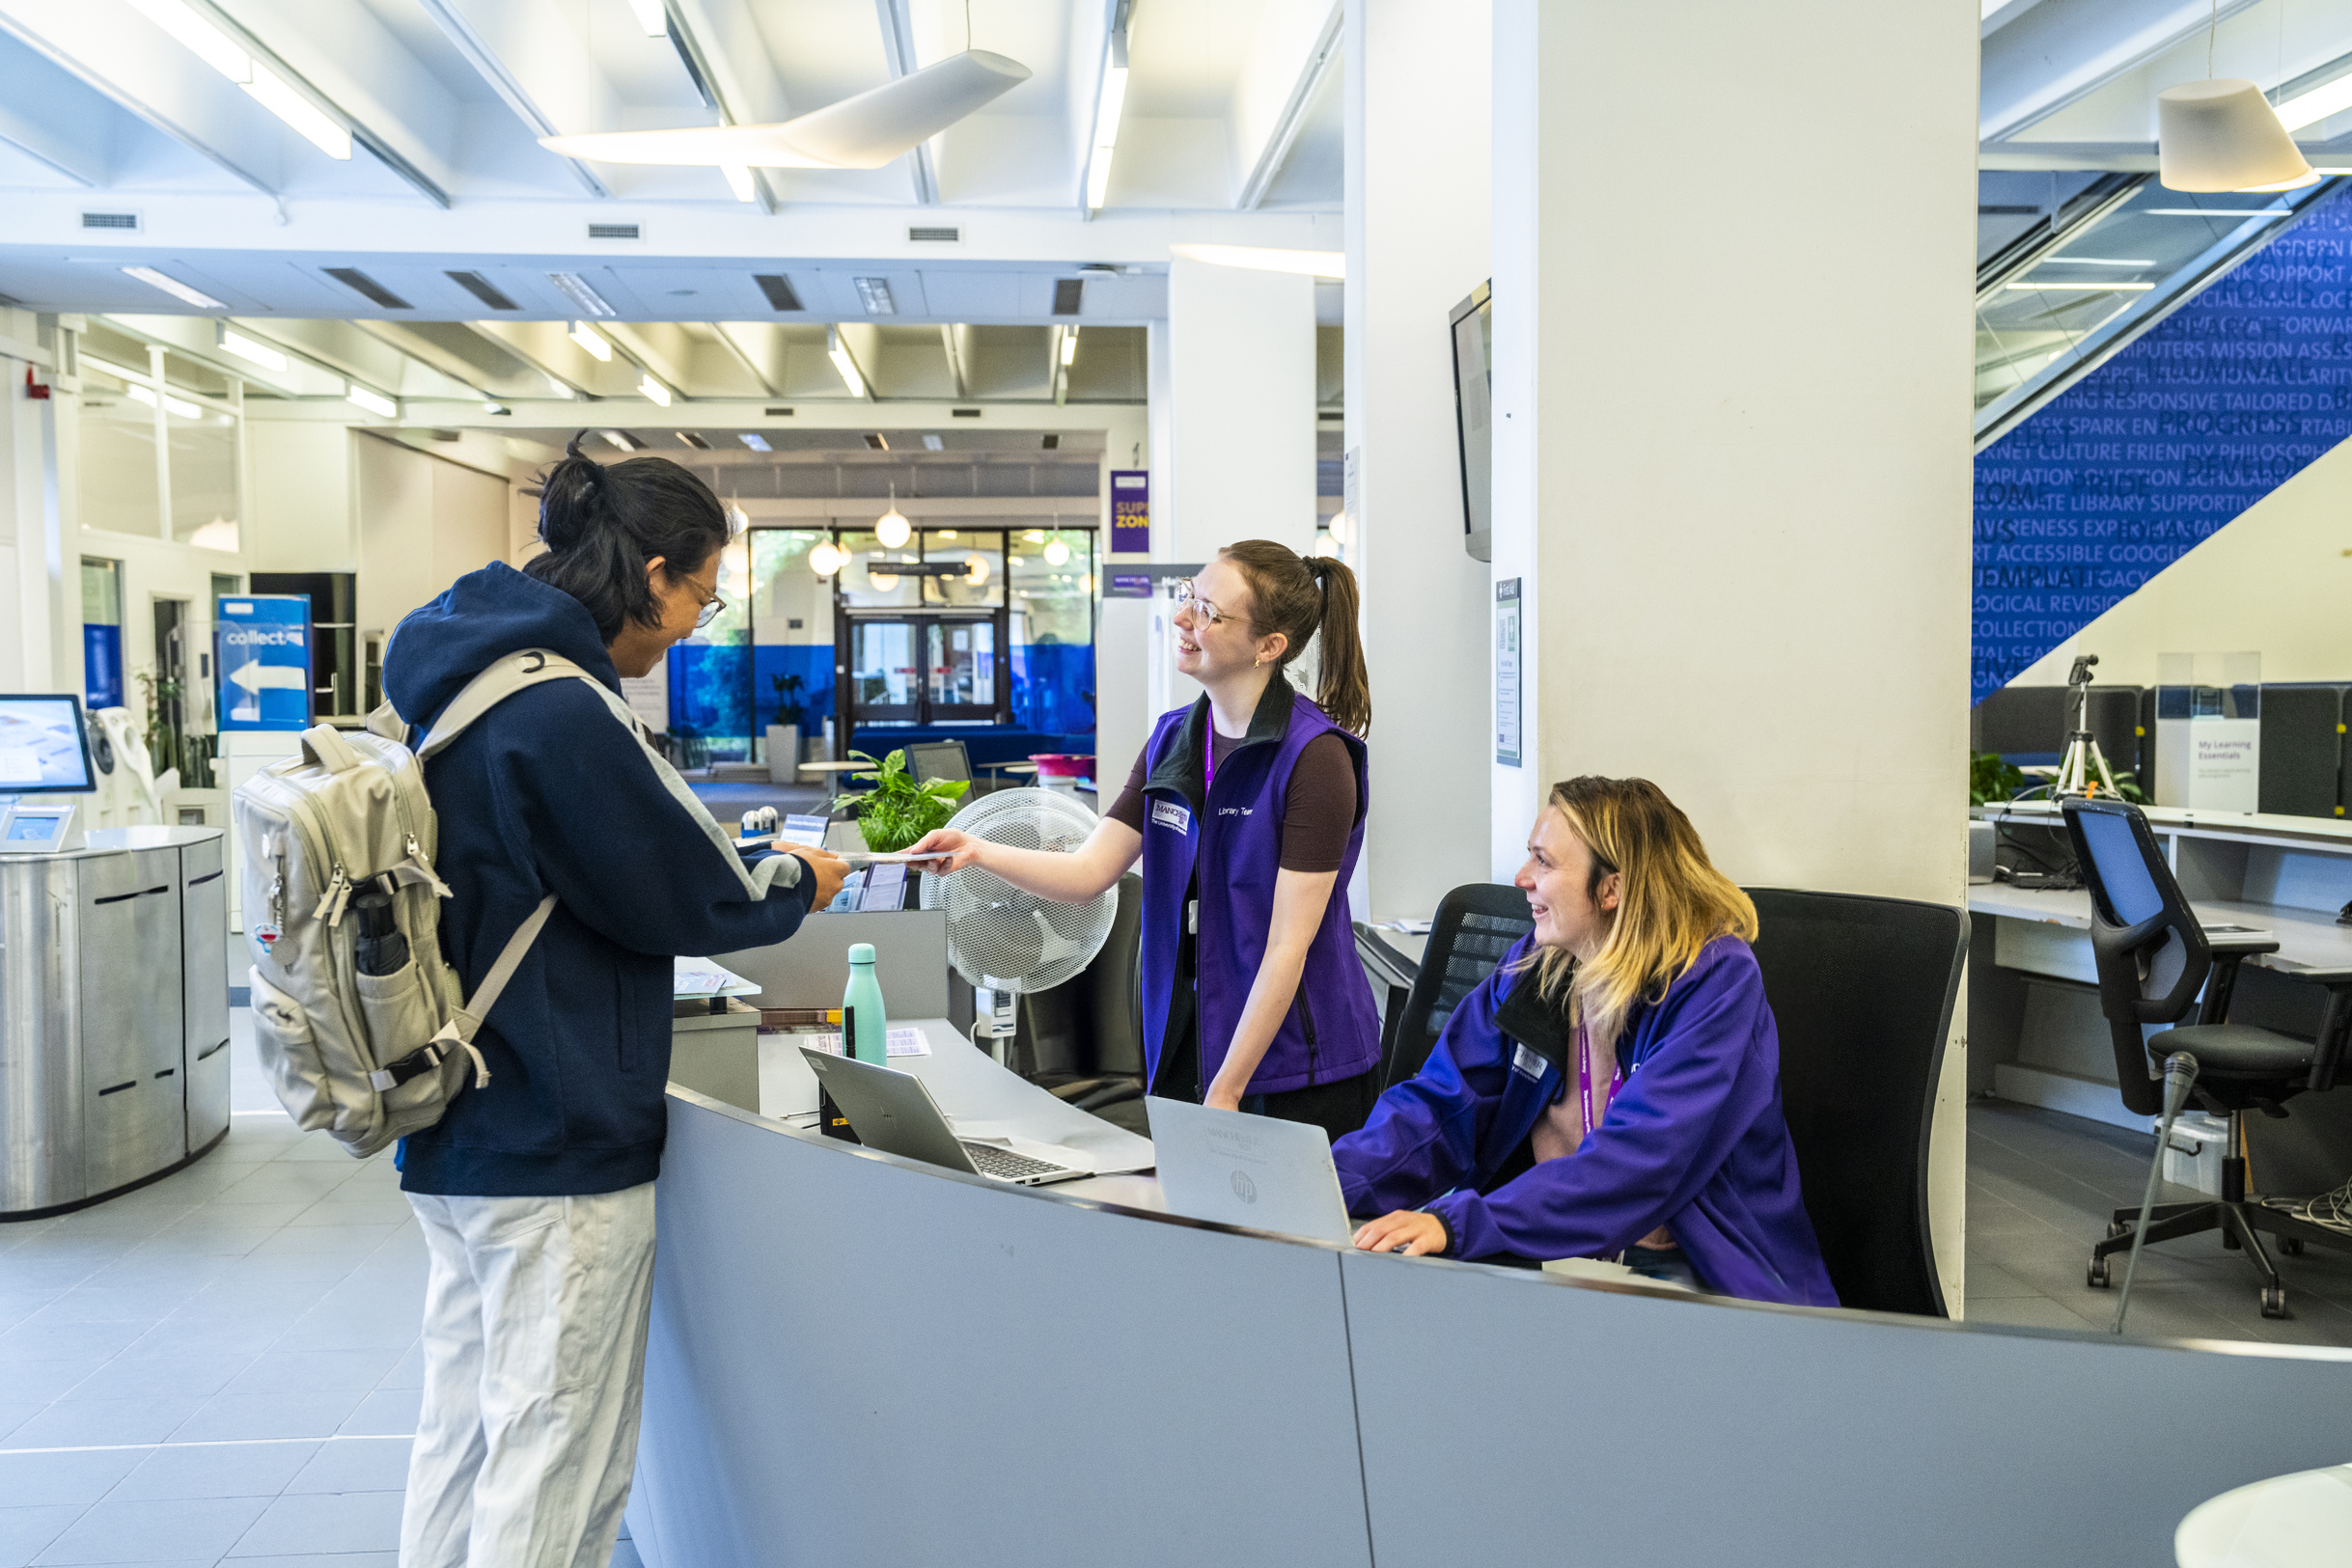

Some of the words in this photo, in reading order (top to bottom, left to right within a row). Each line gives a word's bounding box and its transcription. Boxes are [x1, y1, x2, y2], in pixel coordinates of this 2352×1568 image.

[2258, 265, 2346, 283] SUPPORT
[2210, 342, 2292, 359] MISSION
[2103, 393, 2219, 410] RESPONSIVE
[2225, 393, 2312, 410] TAILORED
[2068, 418, 2126, 435] SPARK
[2158, 410, 2302, 434] PROGRESS
[2038, 444, 2120, 460] CULTURE
[2126, 444, 2214, 461] FRIENDLY
[2219, 444, 2331, 461] PHILOSOPH
[2070, 494, 2144, 511] LIBRARY
[1996, 545, 2104, 562] ACCESSIBLE
[2199, 740, 2212, 750] My
[2214, 740, 2252, 750] Learning
[2199, 751, 2241, 759] Essentials
[1218, 808, 1239, 816] Library
